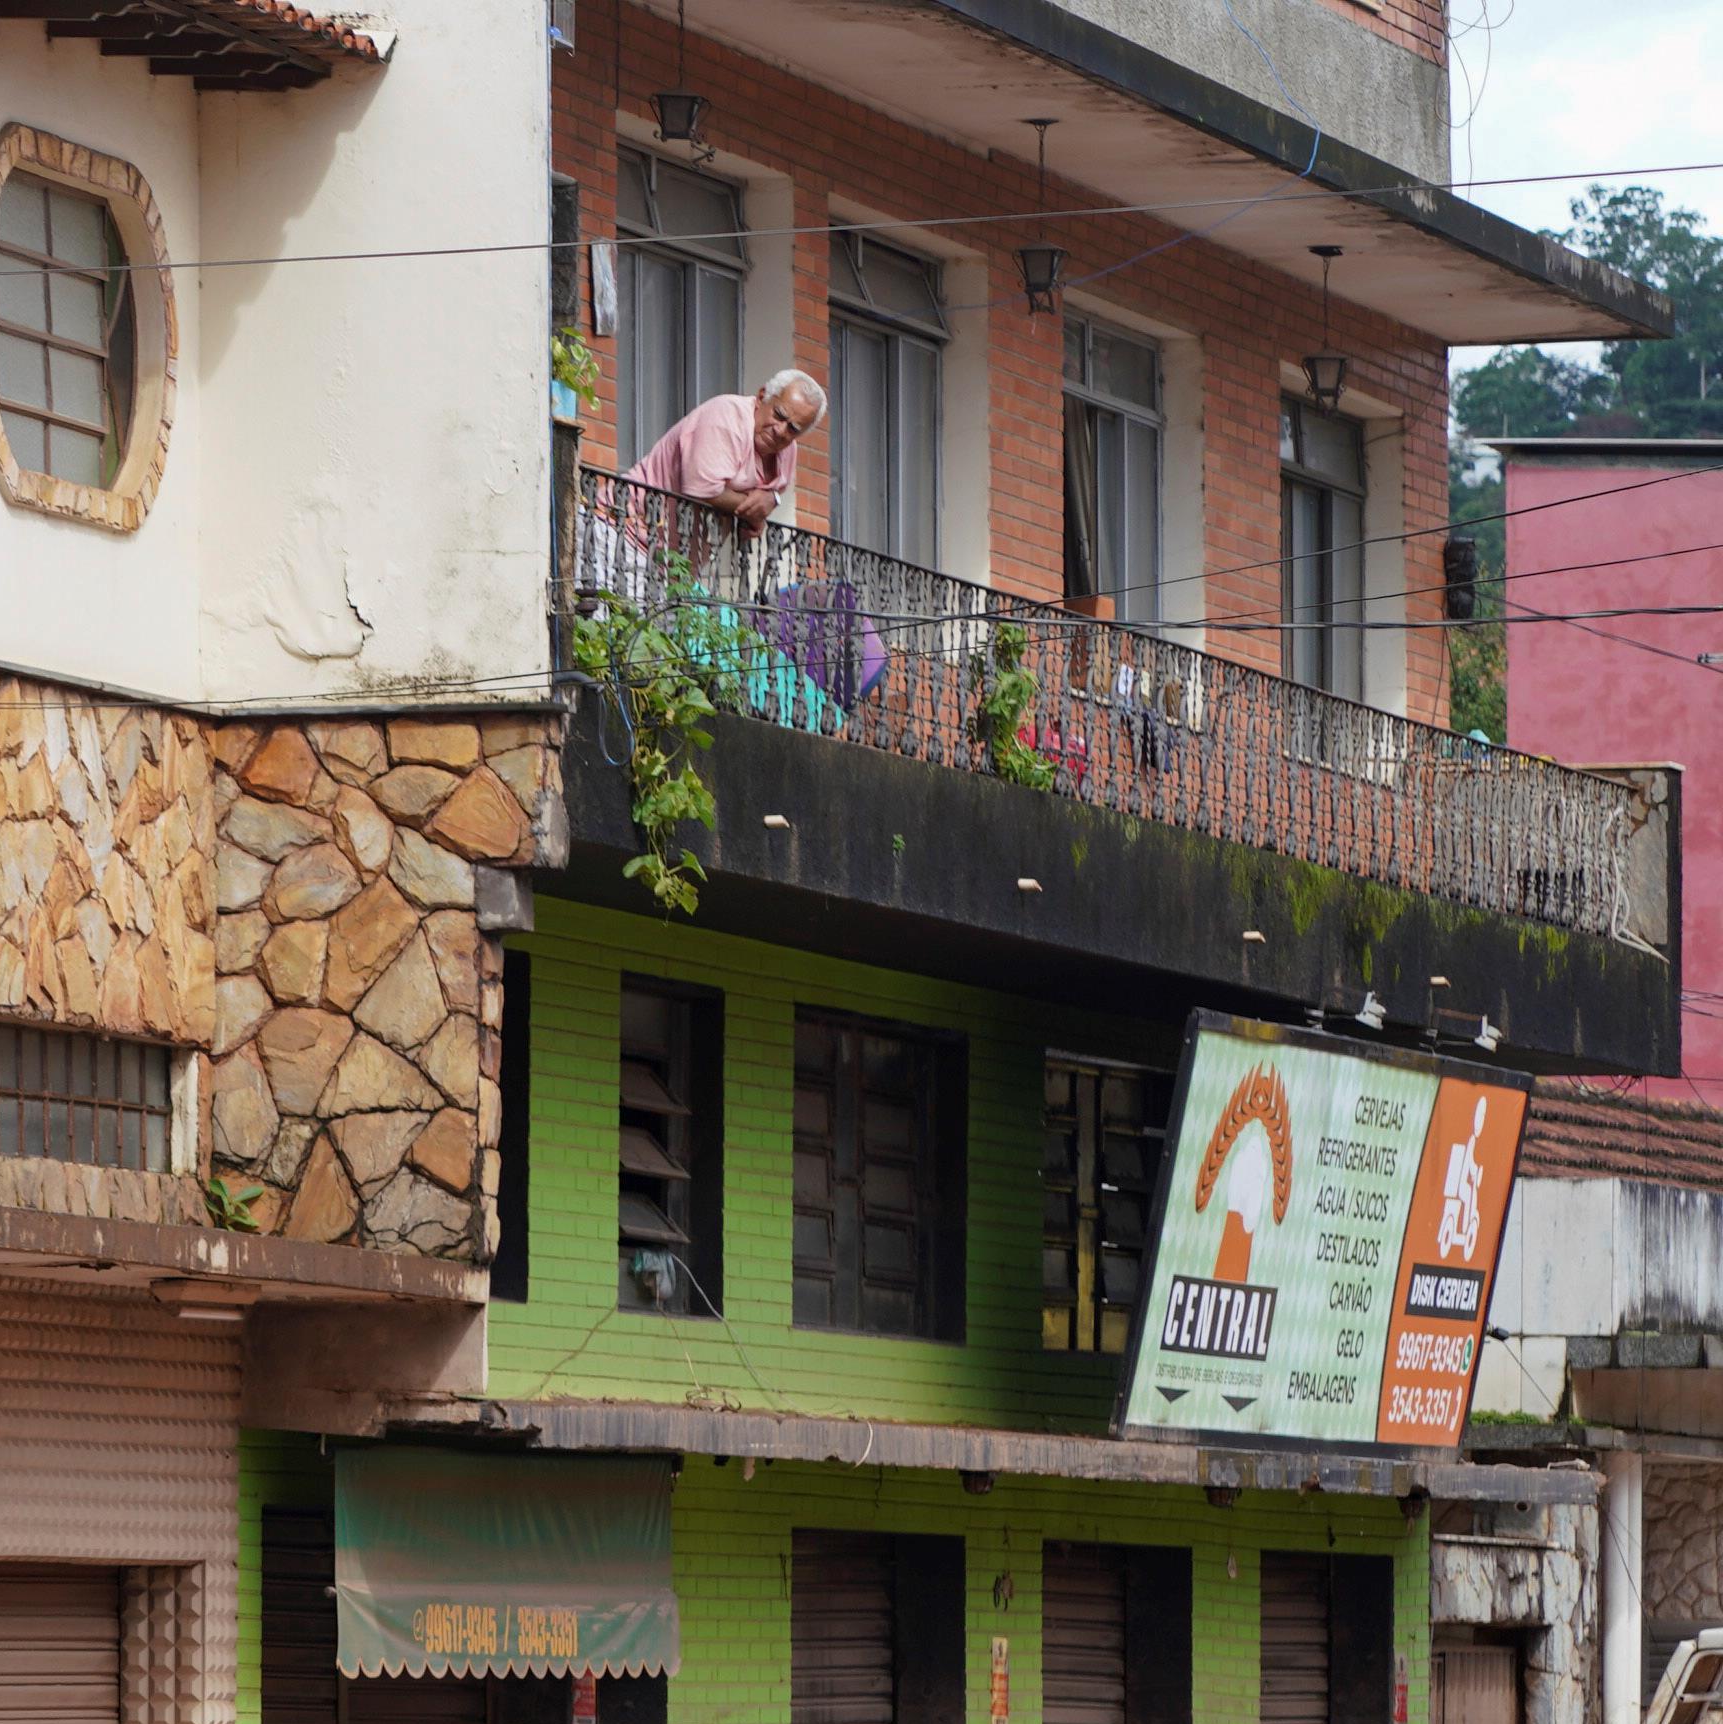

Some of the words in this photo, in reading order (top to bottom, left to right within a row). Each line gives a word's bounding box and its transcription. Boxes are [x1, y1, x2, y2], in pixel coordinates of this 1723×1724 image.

[1355, 1095, 1406, 1131] CERVEJAS
[1316, 1137, 1397, 1176] REFRIGERANTES
[1314, 1176, 1346, 1216] ÁGUA
[1353, 1190, 1389, 1222] SUCOS
[1316, 1232, 1381, 1268] DESTILADOS
[1329, 1277, 1372, 1313] CARVÃO
[1410, 1274, 1438, 1307] DISK
[1436, 1277, 1479, 1311] CERVEJA
[1164, 1280, 1272, 1356] CENTRAL
[1336, 1328, 1364, 1359] GELO
[1396, 1331, 1464, 1375] 99617-9345
[1287, 1370, 1356, 1404] EMBALAGENS
[1388, 1385, 1452, 1426] 3543-3351
[425, 1603, 497, 1656] 99617-9345
[518, 1606, 578, 1657] 3543-3351
